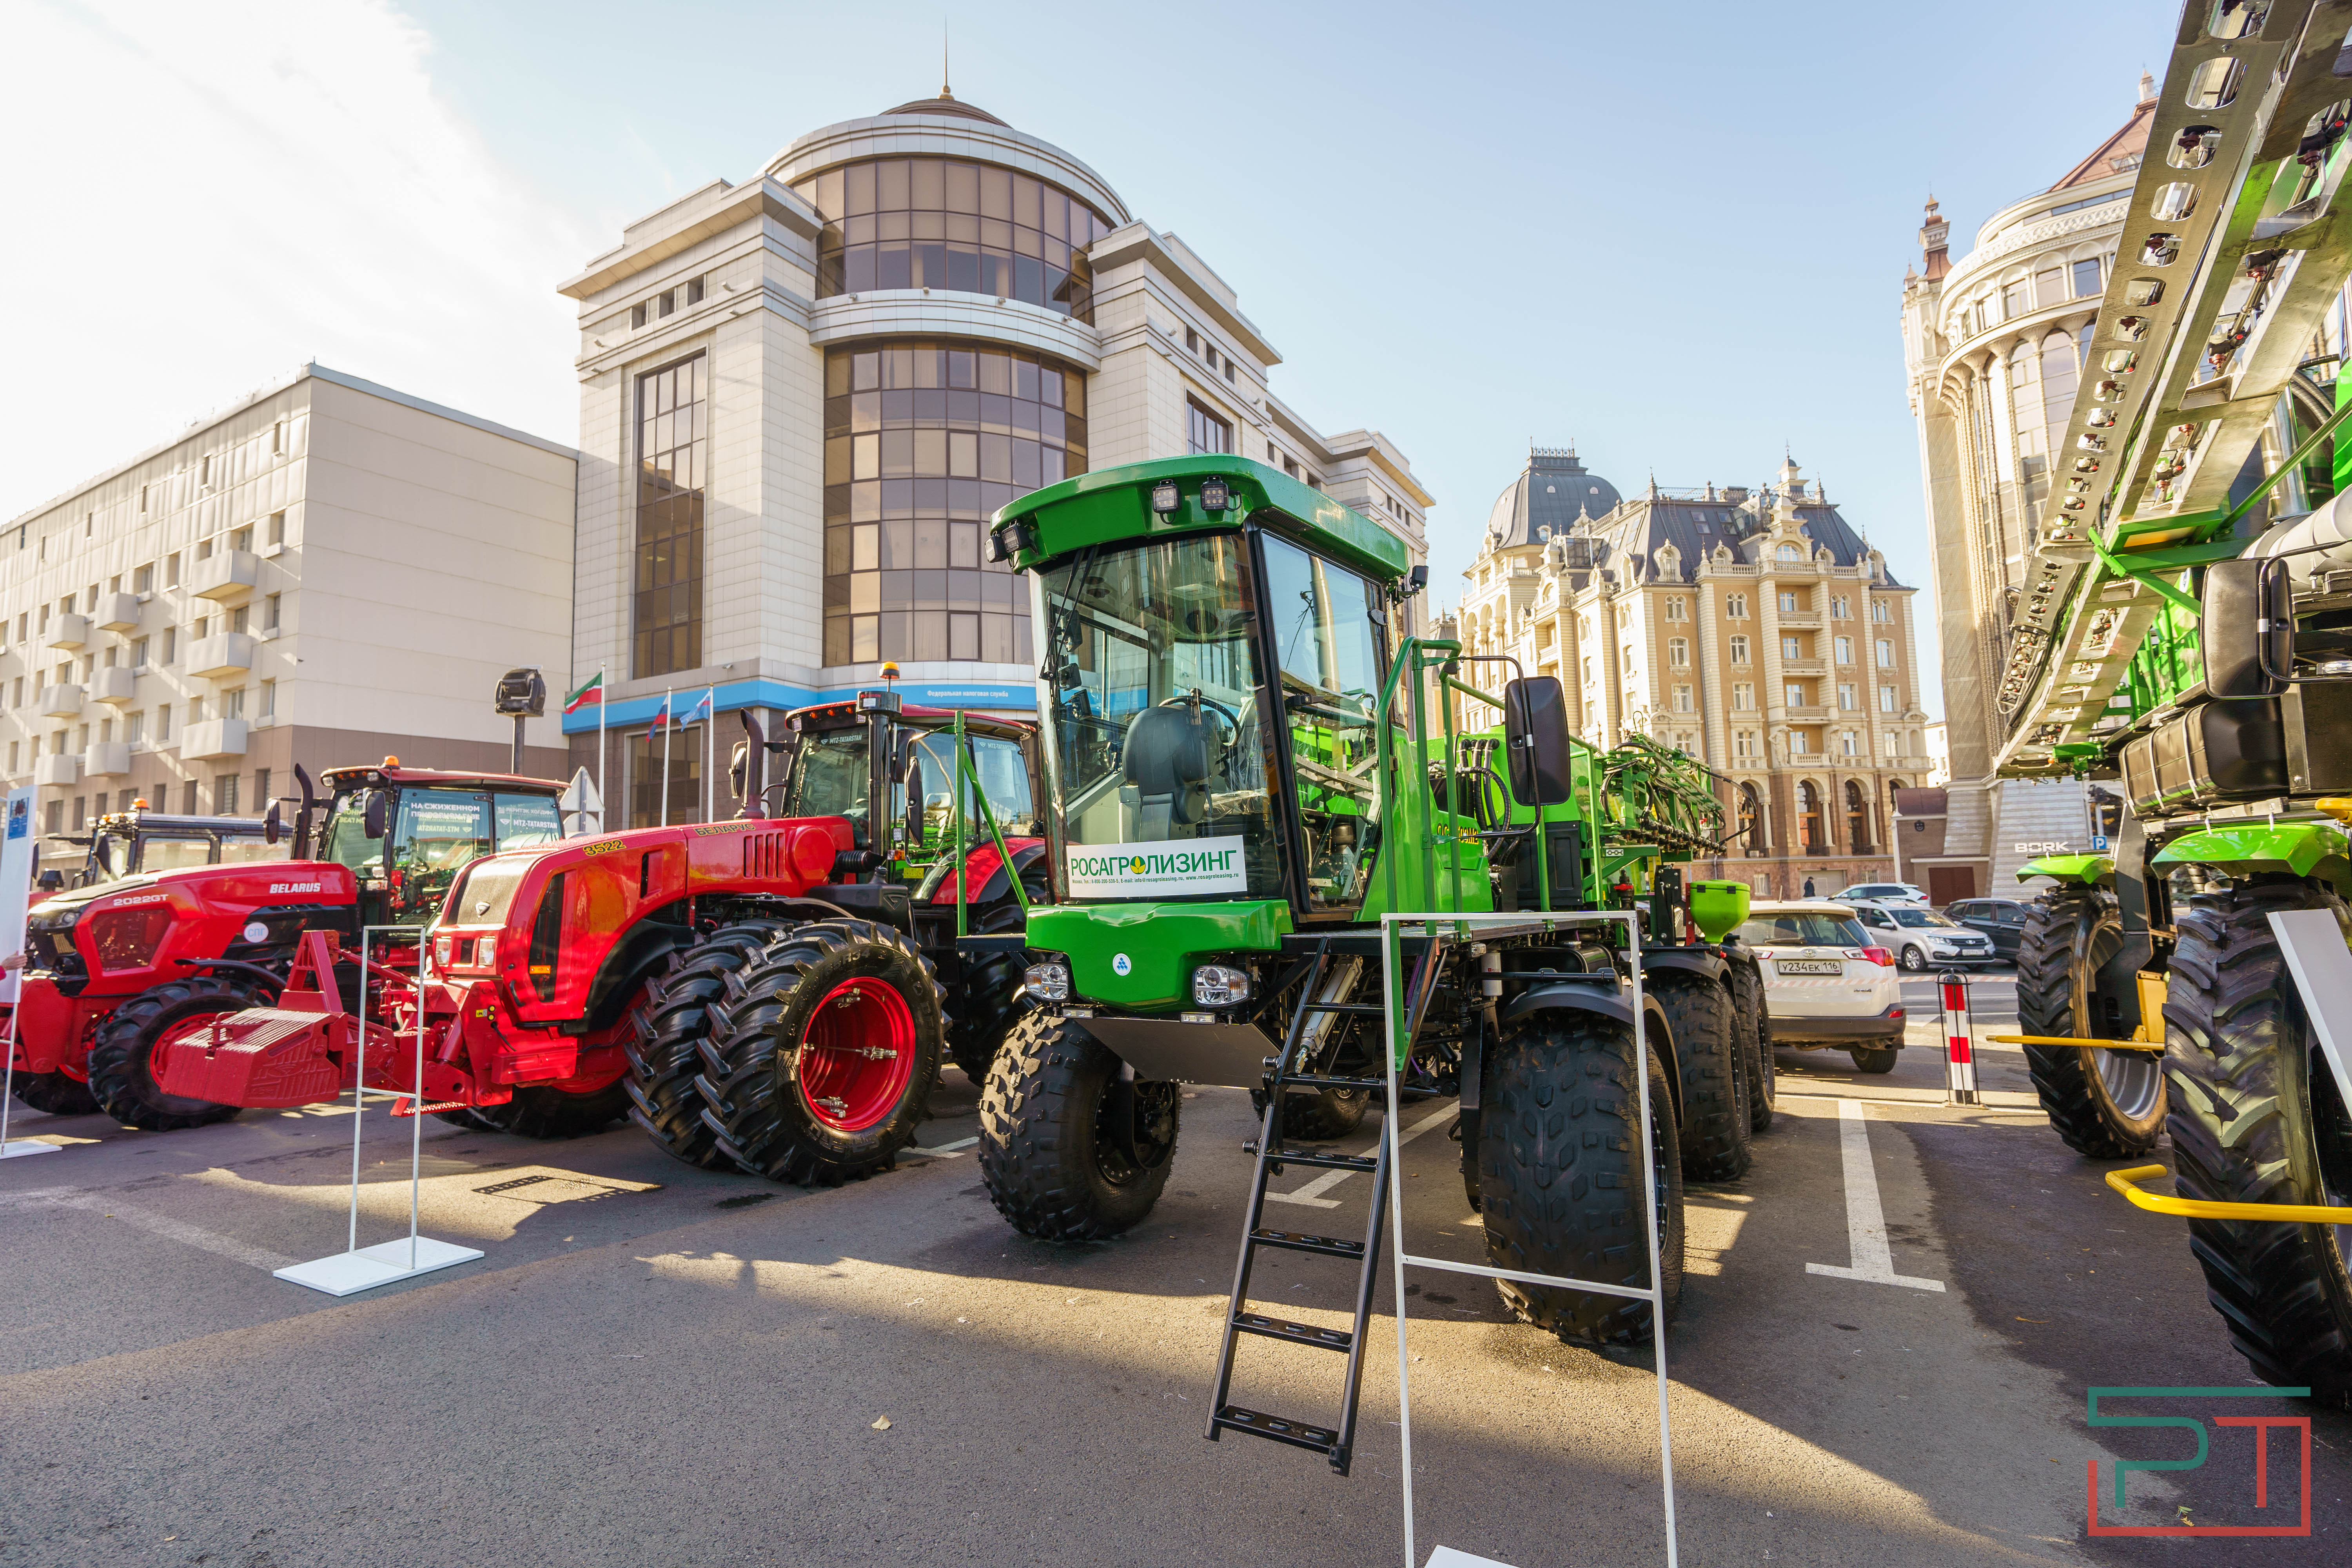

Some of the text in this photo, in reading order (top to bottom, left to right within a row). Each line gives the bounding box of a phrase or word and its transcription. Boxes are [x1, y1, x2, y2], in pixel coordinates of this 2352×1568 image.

[829, 734, 862, 744] MTZ-TATARSTAN
[425, 803, 480, 812] СЖИЖЕННОМ
[513, 819, 557, 829] MTZ-TATARSTAN
[693, 823, 756, 837] БЕЛАРУС
[583, 840, 627, 856] 3522
[2014, 841, 2069, 853] BORK
[2095, 838, 2105, 849] P
[269, 883, 321, 894] BELARUS
[113, 894, 169, 907] 2022GT
